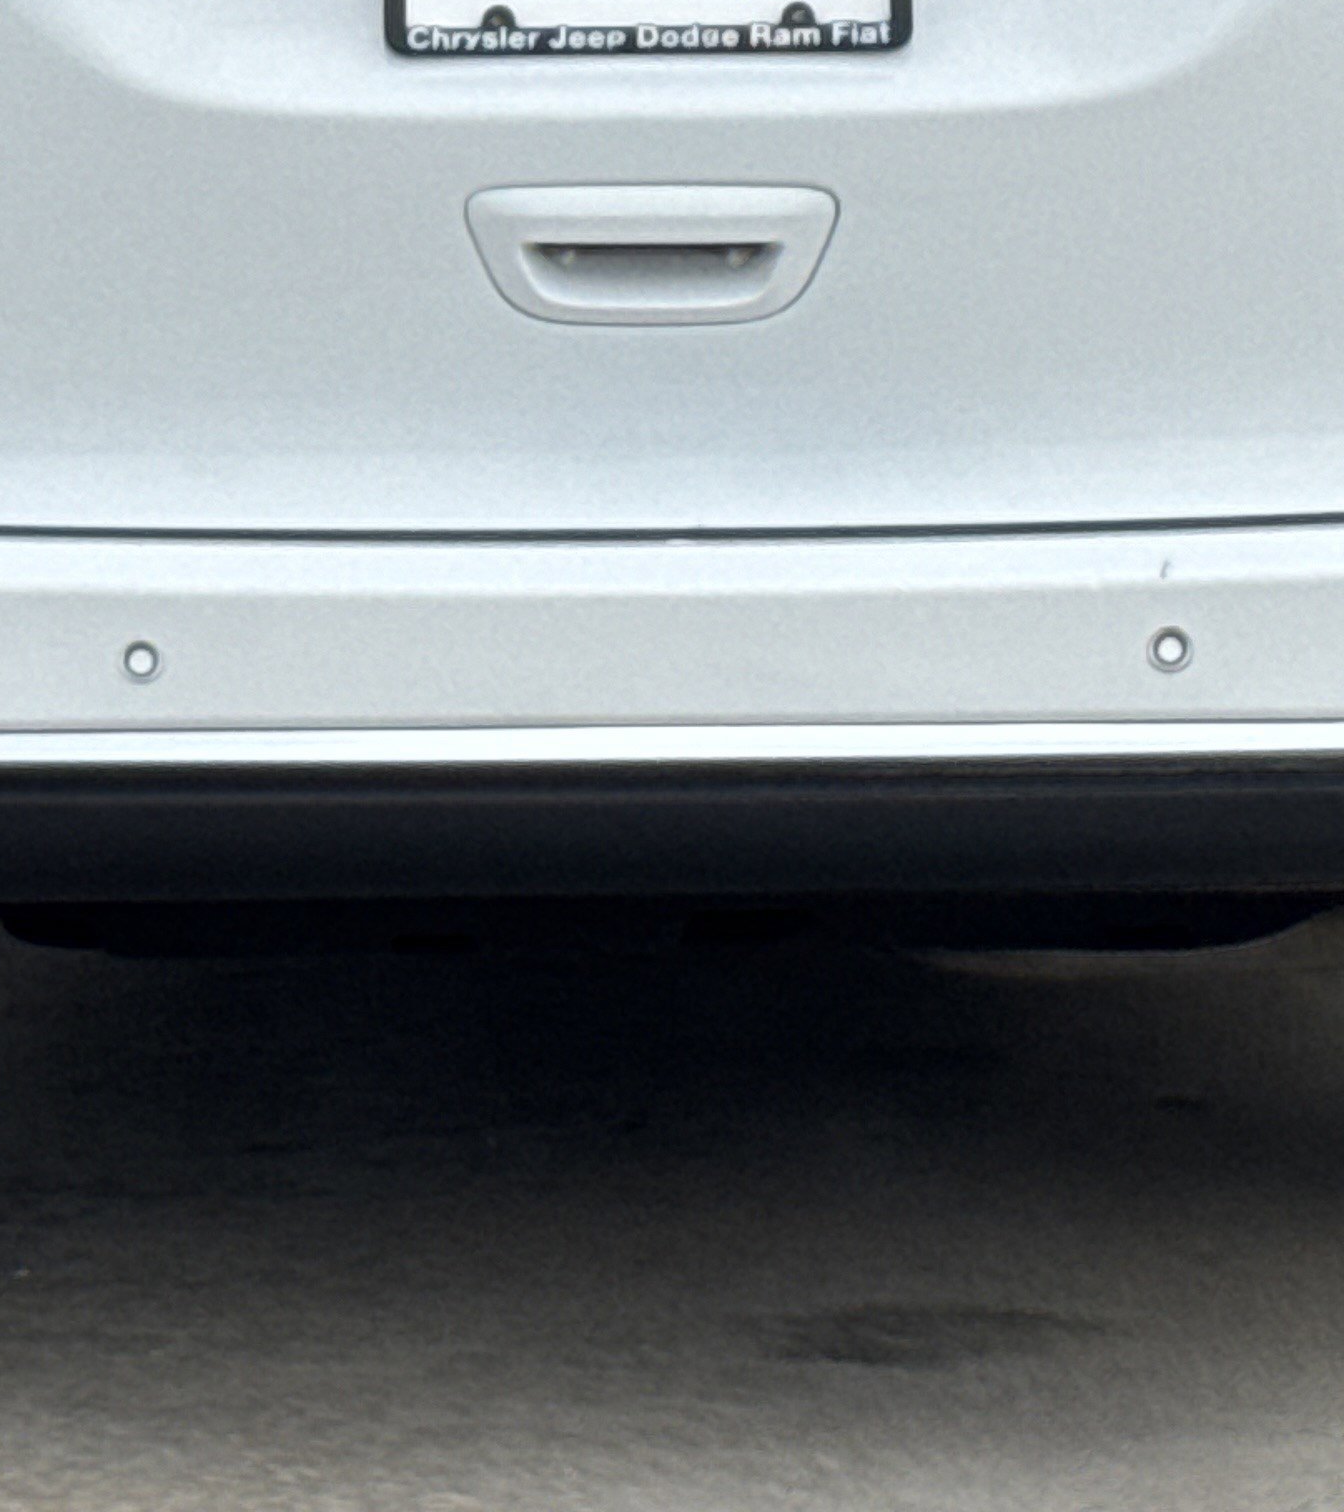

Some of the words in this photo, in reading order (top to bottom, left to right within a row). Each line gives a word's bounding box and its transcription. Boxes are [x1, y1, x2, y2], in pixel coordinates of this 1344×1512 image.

[407, 25, 541, 51] Chrysler
[549, 24, 627, 50] Jeep
[636, 24, 740, 49] Dodge
[749, 23, 821, 48] Ram
[830, 21, 891, 47] Fiat
